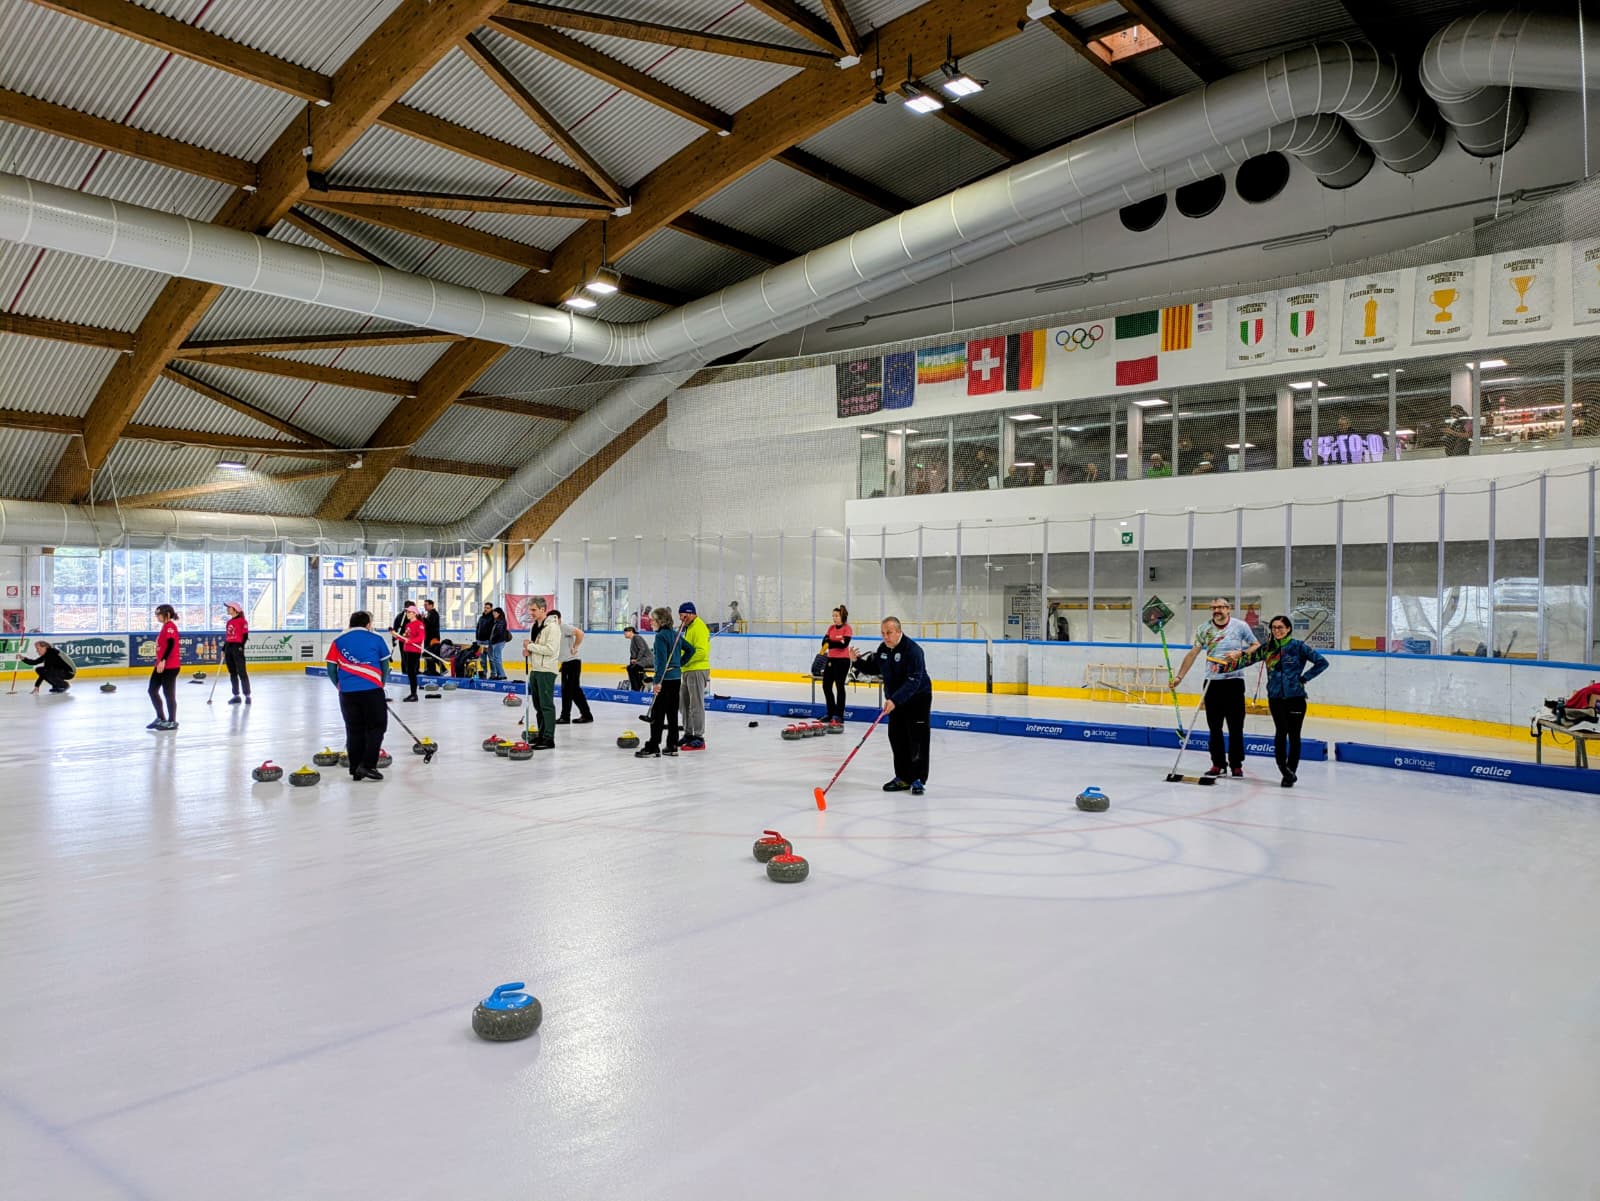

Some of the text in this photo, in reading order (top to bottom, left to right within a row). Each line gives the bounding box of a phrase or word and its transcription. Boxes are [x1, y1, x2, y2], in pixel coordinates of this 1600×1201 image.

[1511, 264, 1529, 272] SERIE
[66, 643, 120, 655] Bernardo
[945, 719, 971, 727] realice
[1025, 724, 1063, 733] intercom
[1246, 743, 1276, 752] realic
[1403, 757, 1436, 767] acinque
[1470, 765, 1512, 776] realice
